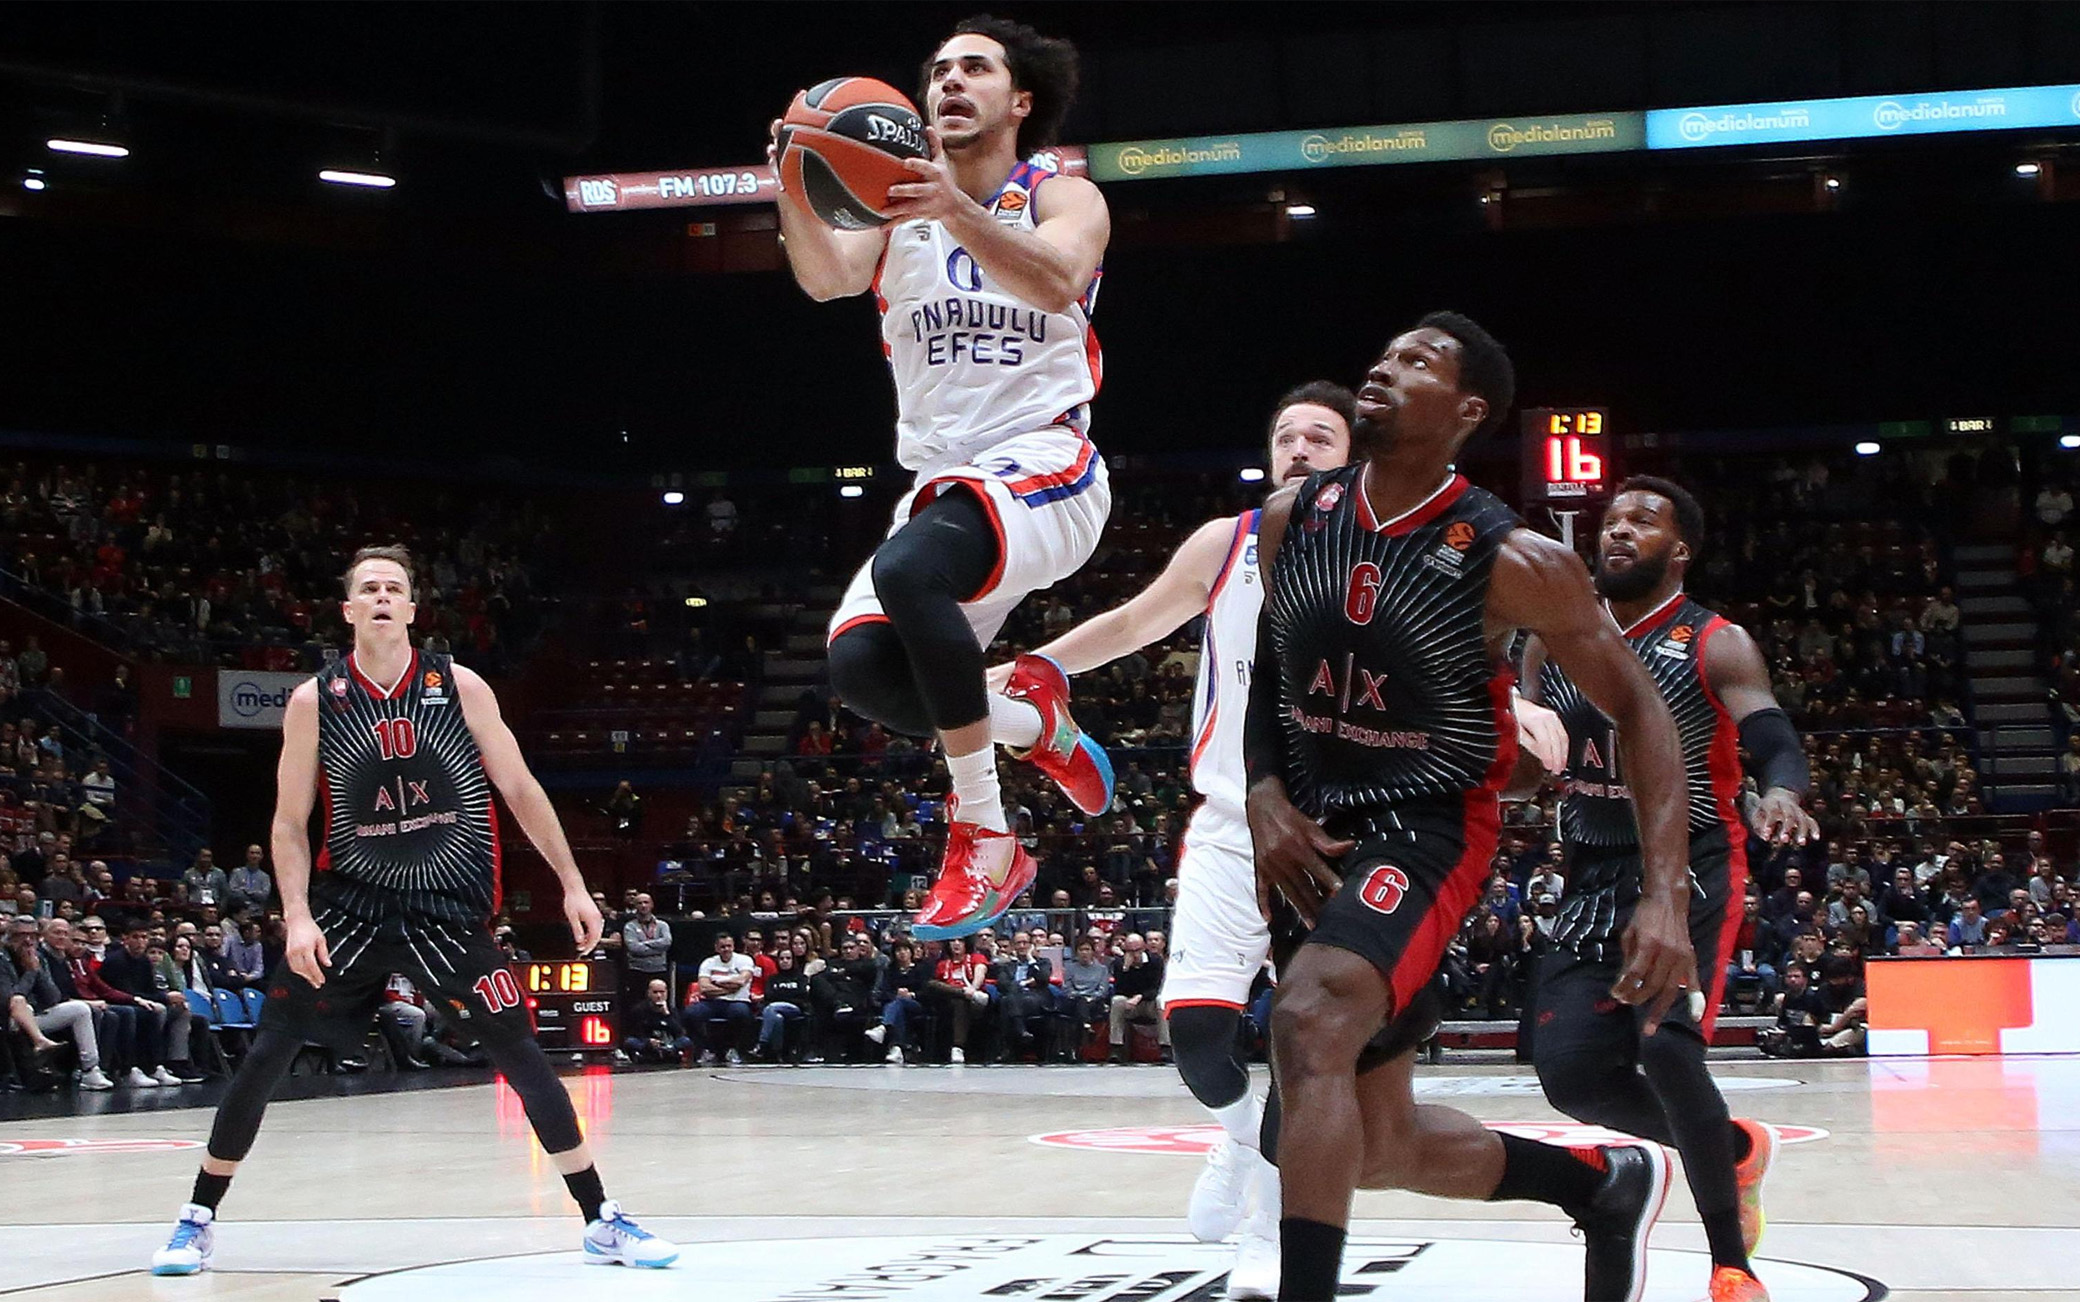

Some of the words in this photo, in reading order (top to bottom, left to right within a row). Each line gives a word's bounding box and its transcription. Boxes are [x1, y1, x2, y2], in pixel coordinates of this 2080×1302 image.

[1681, 114, 1810, 137] mediolanum
[1876, 103, 2006, 125] mediolanum
[867, 114, 925, 157] SPALD
[1303, 136, 1426, 158] mediolanum
[1489, 125, 1615, 147] mediolanum
[1028, 152, 1060, 173] DS
[1121, 148, 1240, 171] mediolanum
[580, 180, 617, 205] RDS
[658, 176, 695, 198] FM
[701, 172, 758, 196] 107.3
[946, 246, 982, 292] 0
[927, 332, 1024, 366] EFES
[1958, 419, 1985, 432] BAR
[1547, 436, 1602, 481] 16
[1344, 561, 1382, 625] 6
[373, 717, 417, 761] 10
[1338, 720, 1430, 750] EXCHANGE
[1359, 865, 1410, 915] 6
[472, 969, 520, 1013] 10
[573, 1001, 611, 1012] GUEST
[583, 1016, 612, 1044] 16
